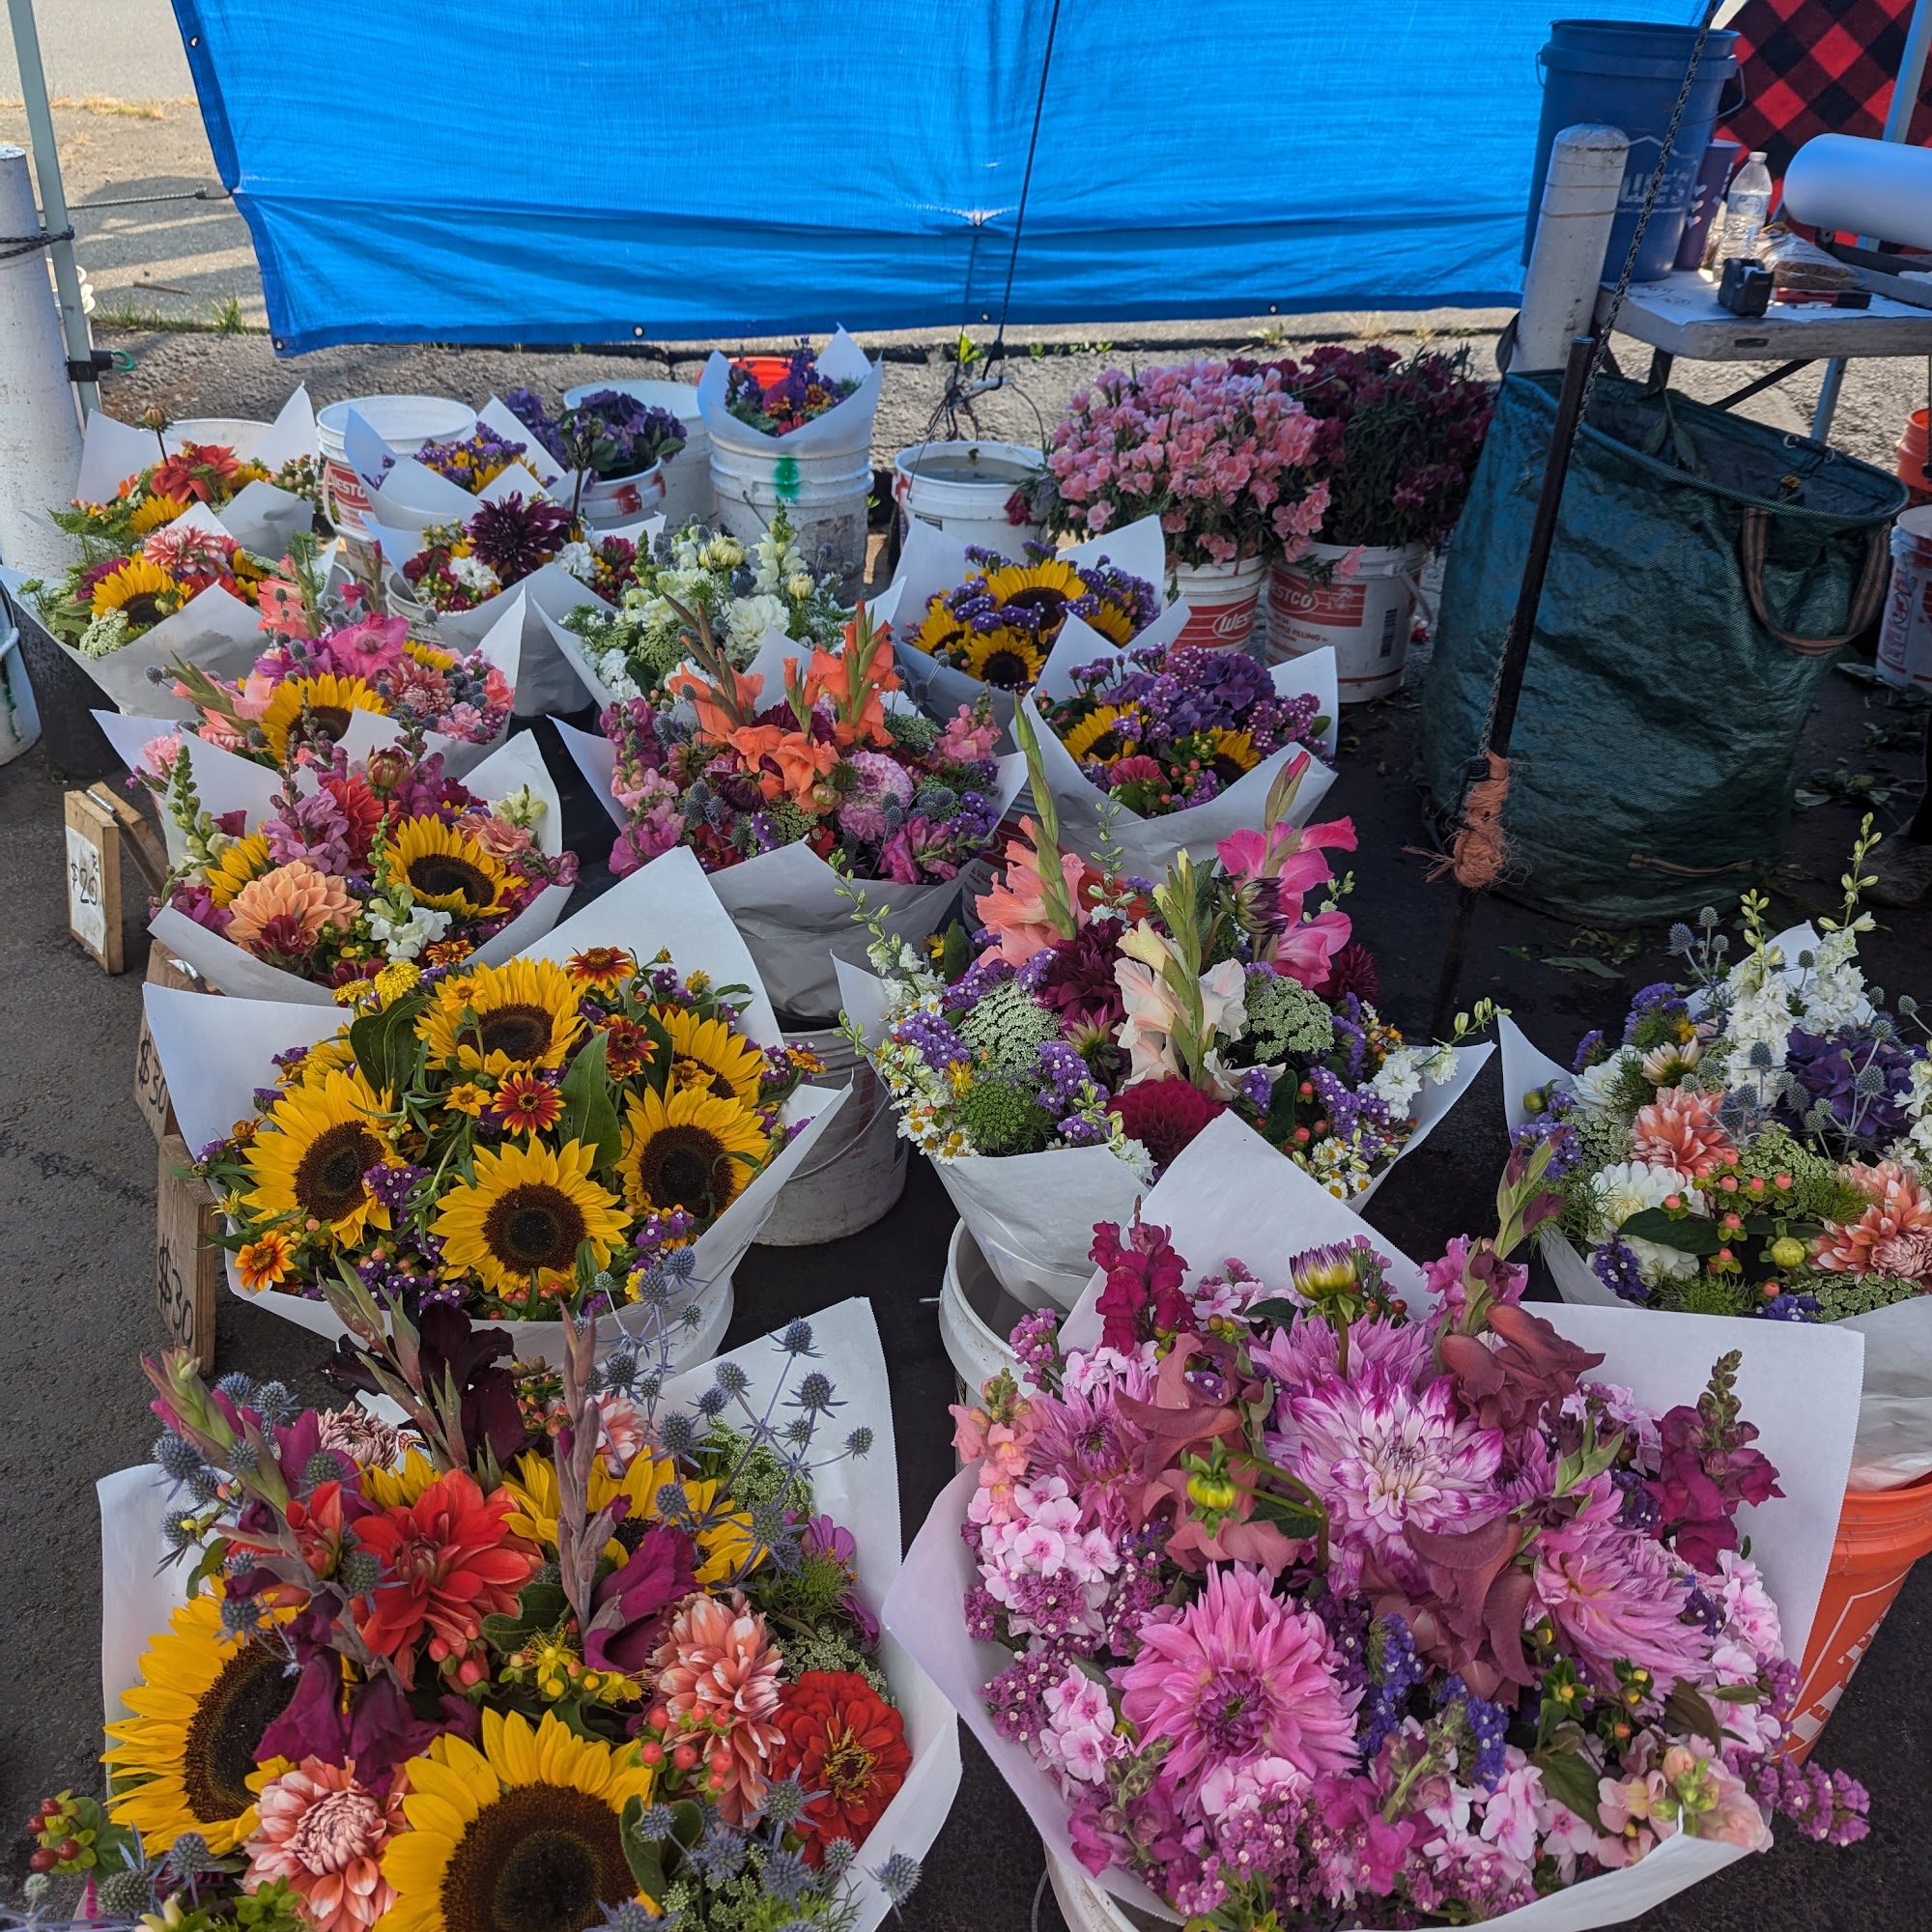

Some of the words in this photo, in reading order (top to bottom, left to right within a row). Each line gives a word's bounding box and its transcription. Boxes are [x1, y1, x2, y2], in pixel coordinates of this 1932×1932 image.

[71, 858, 98, 906] $20
[138, 1029, 167, 1115] $30
[157, 1233, 194, 1349] $30
